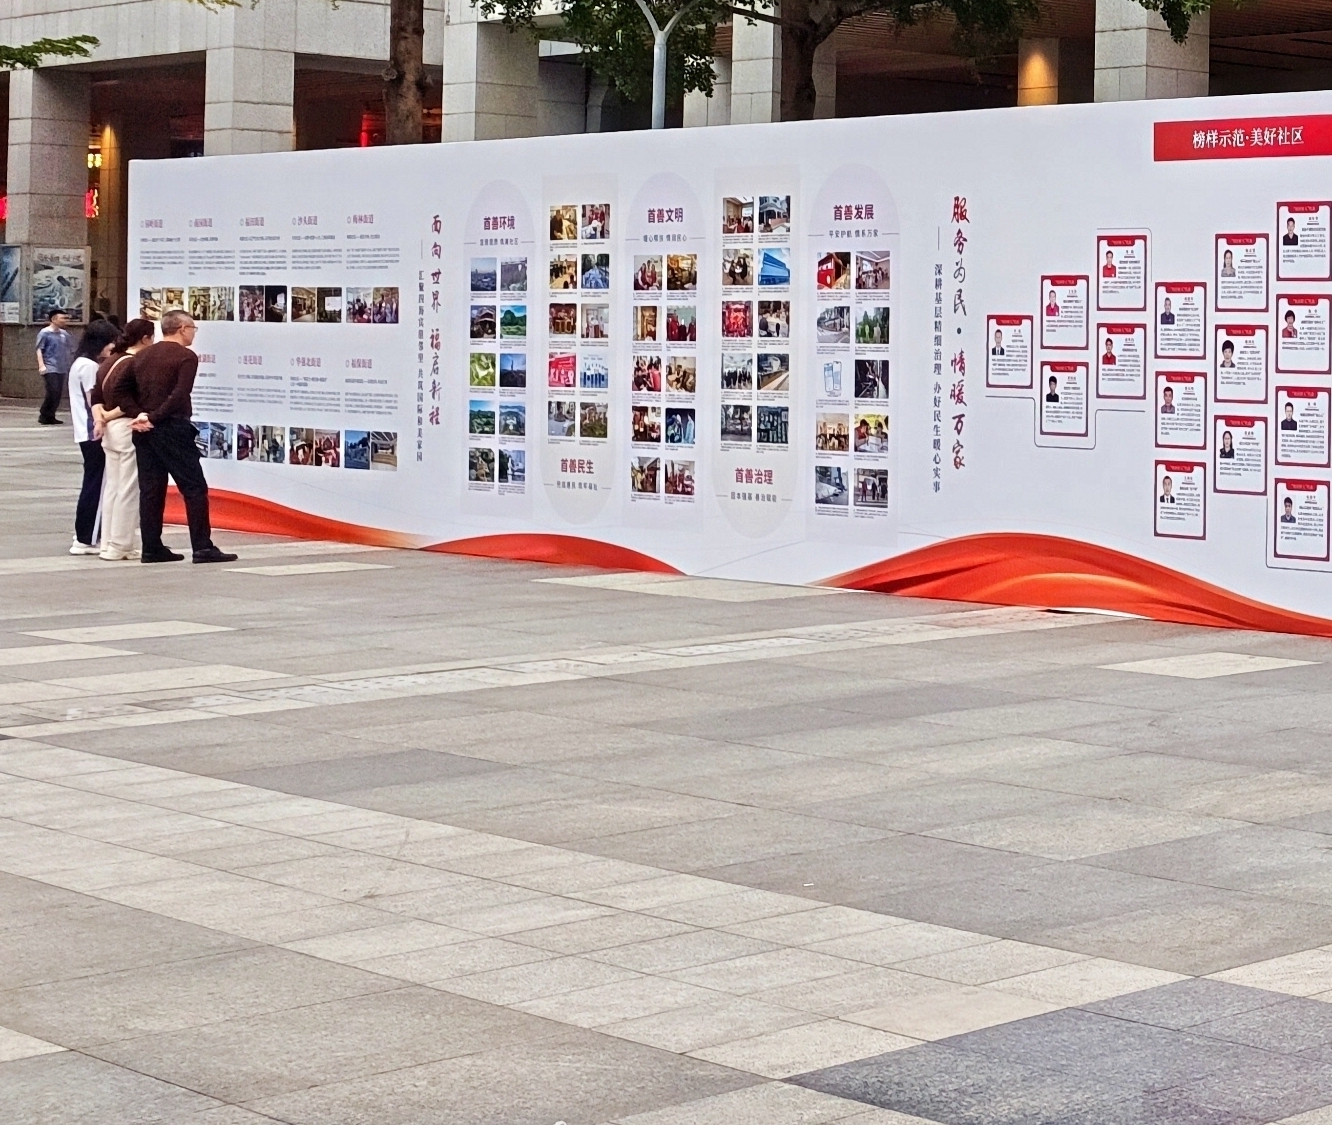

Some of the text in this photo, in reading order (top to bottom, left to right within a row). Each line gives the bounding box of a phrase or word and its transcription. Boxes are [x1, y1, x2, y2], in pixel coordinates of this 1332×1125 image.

[1192, 124, 1304, 149] 榜样示范·美好社区
[647, 207, 684, 224] 首善文明
[833, 204, 874, 221] 首善发展
[483, 215, 516, 232] 首善环境
[429, 214, 442, 313] 面向世界
[560, 458, 595, 475] 首善民生
[734, 467, 774, 486] 首善治理
